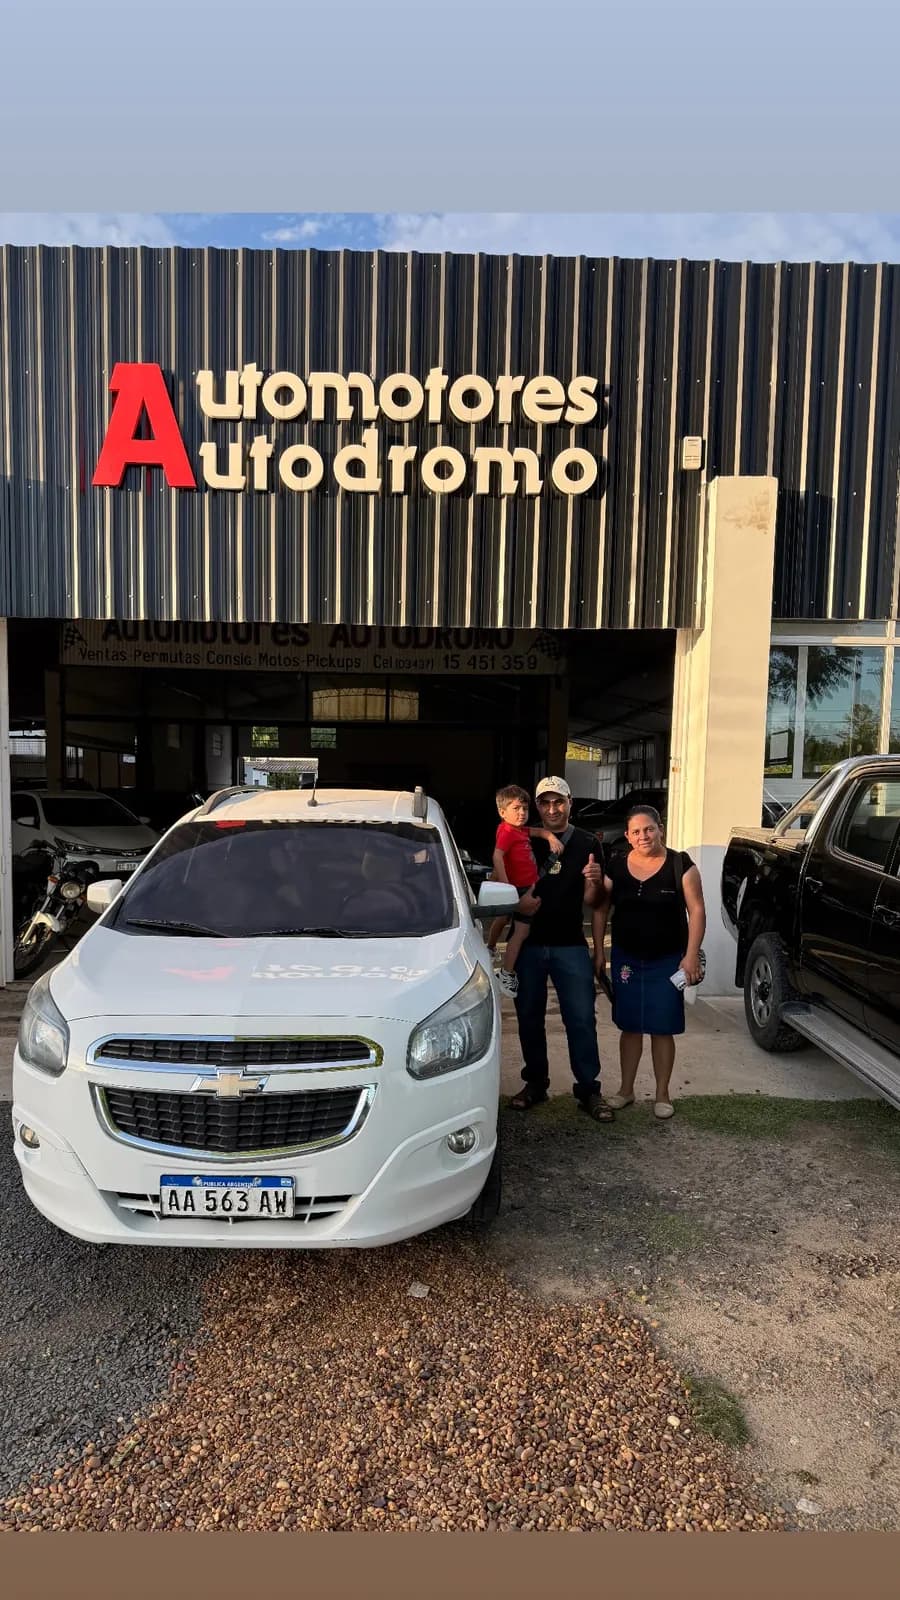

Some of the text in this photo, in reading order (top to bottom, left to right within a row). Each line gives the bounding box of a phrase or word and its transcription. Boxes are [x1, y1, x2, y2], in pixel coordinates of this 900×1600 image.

[79, 648, 127, 662] Ventas
[133, 650, 201, 666] Permutas
[443, 654, 460, 670] 15
[168, 1190, 287, 1213] AA 563 AW
